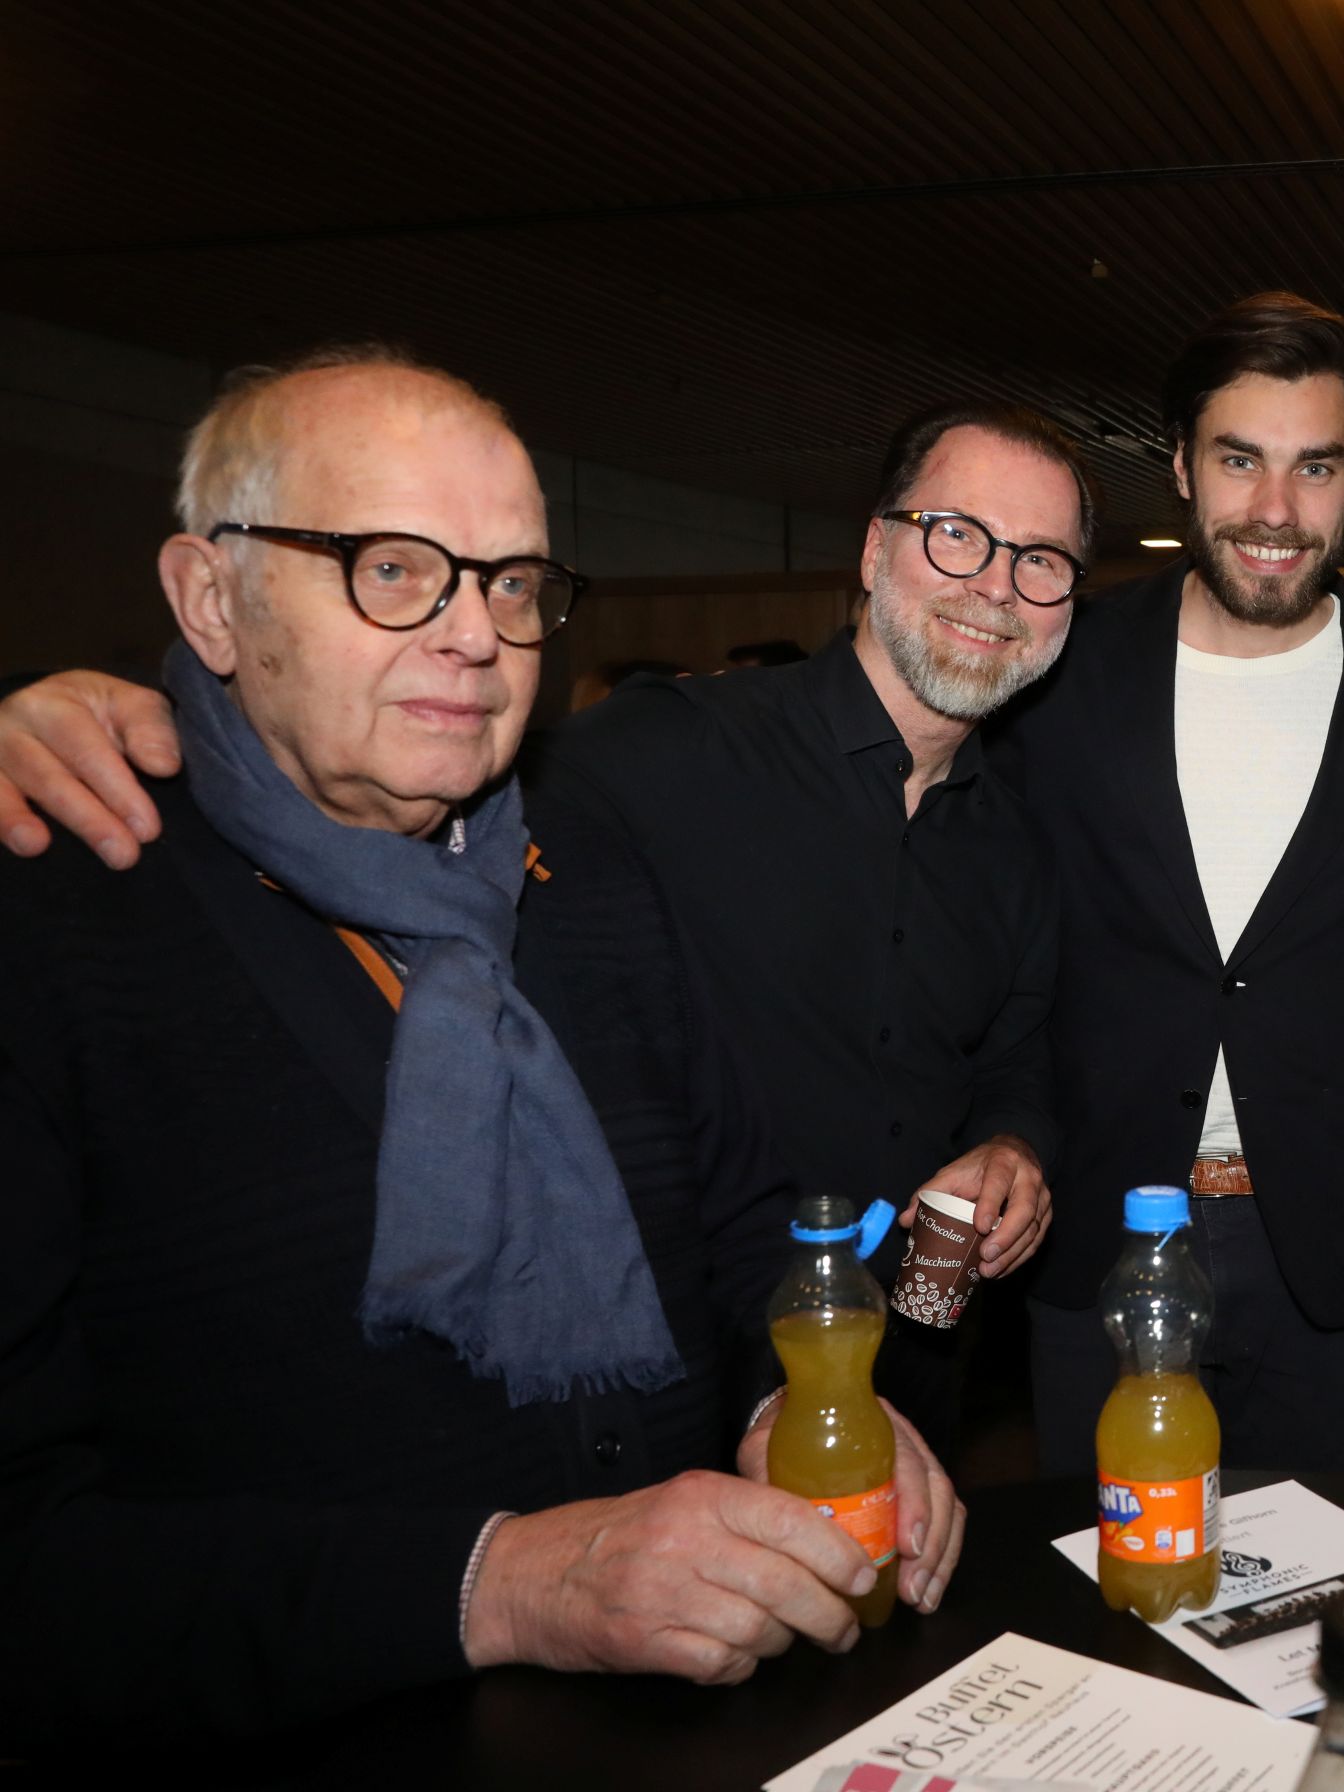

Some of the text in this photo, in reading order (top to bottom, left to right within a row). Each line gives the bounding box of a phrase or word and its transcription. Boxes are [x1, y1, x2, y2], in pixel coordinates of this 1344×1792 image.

[925, 1217, 966, 1244] Chocolate
[914, 1254, 962, 1269] Macchiato
[1220, 1563, 1310, 1594] SYMPHONIC
[1243, 1575, 1301, 1595] FLAMES
[915, 1661, 1020, 1725] Buffet
